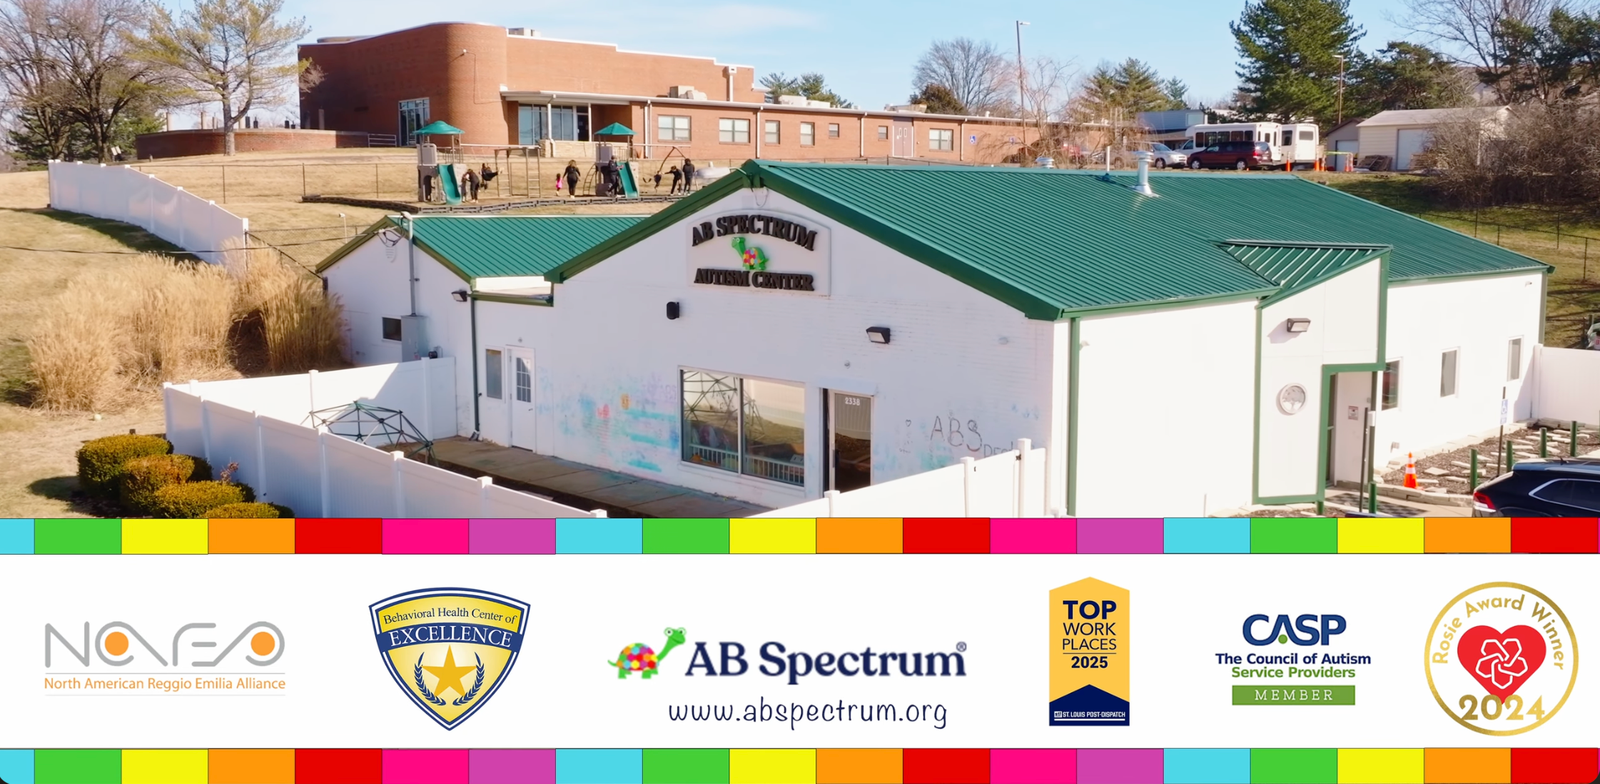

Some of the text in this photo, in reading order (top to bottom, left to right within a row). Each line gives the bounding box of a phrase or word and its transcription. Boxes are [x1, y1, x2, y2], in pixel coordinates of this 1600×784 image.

[692, 214, 818, 252] AB SPECTRUM
[693, 268, 815, 291] AUTISM CENTER
[929, 415, 983, 452] ABS
